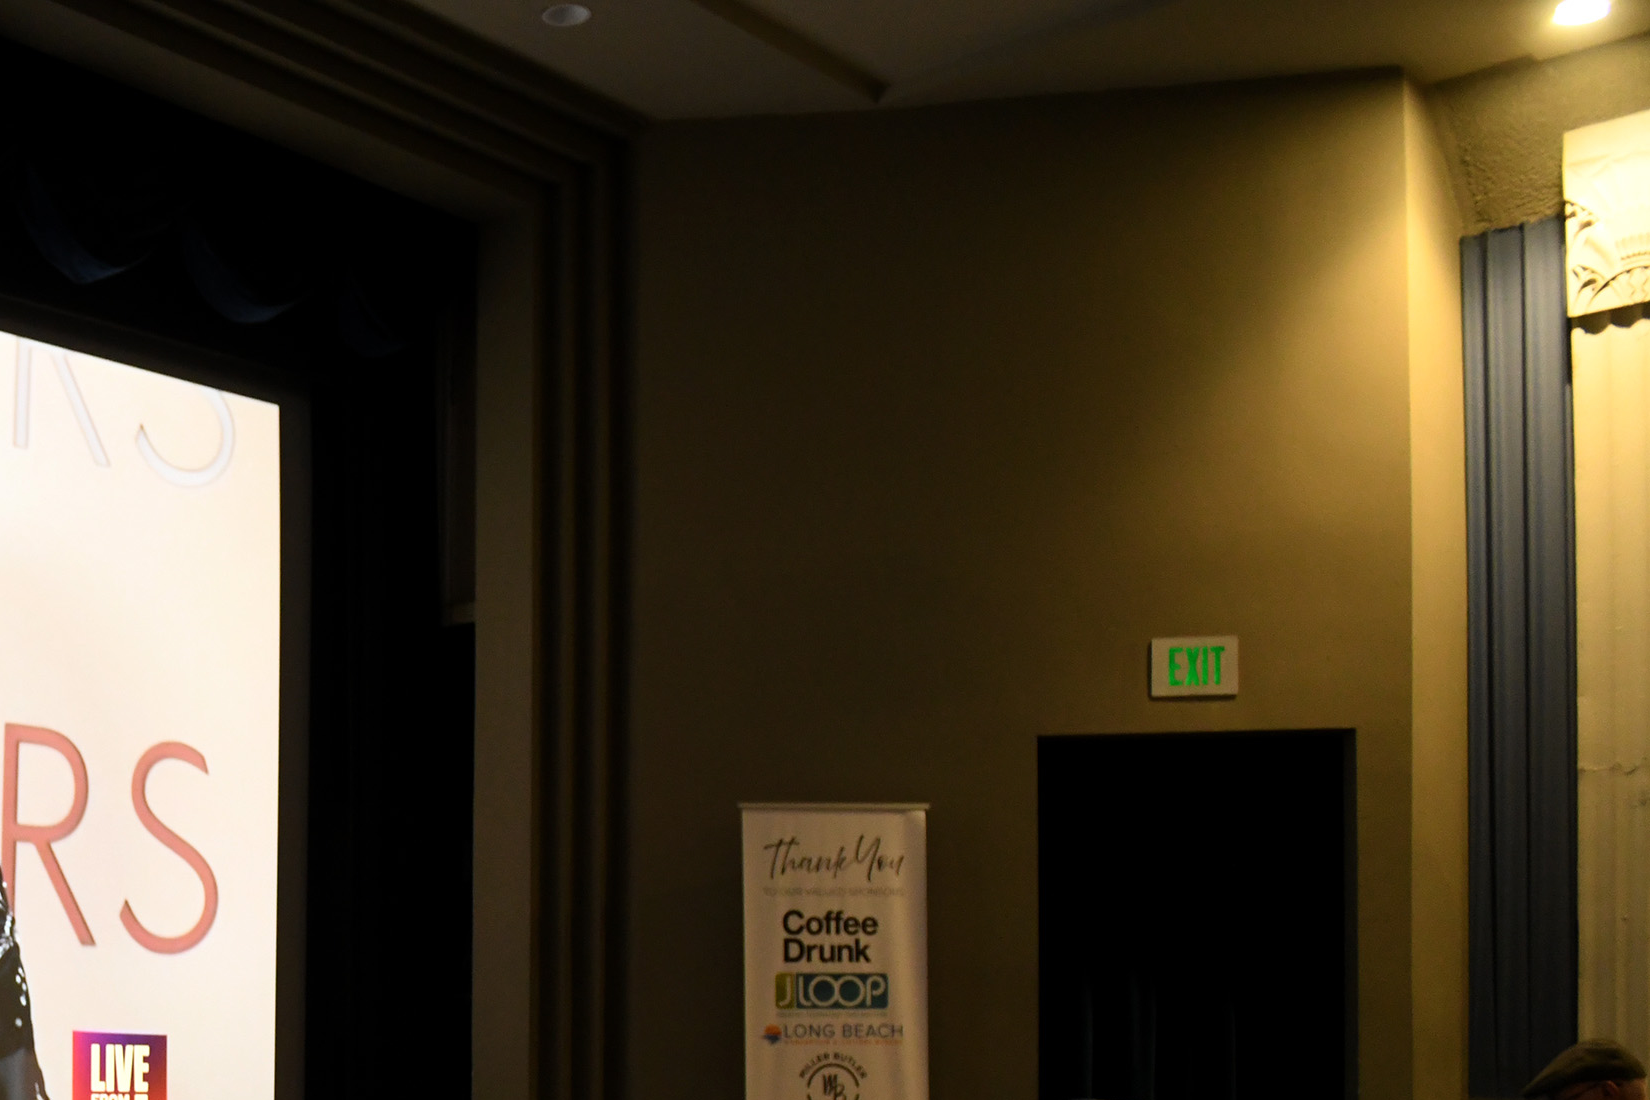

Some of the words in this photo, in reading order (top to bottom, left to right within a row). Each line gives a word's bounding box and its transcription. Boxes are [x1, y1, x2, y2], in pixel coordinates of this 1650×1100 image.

[1169, 646, 1225, 686] EXIT
[764, 836, 848, 880] Thank
[850, 835, 904, 882] You
[783, 909, 878, 936] Coffee
[783, 938, 871, 963] Drunk
[783, 1024, 835, 1037] LONG
[842, 1023, 903, 1037] BEACH
[91, 1043, 150, 1092] LIVE
[799, 1053, 830, 1079] MILLER
[833, 1052, 868, 1080] BUTLER
